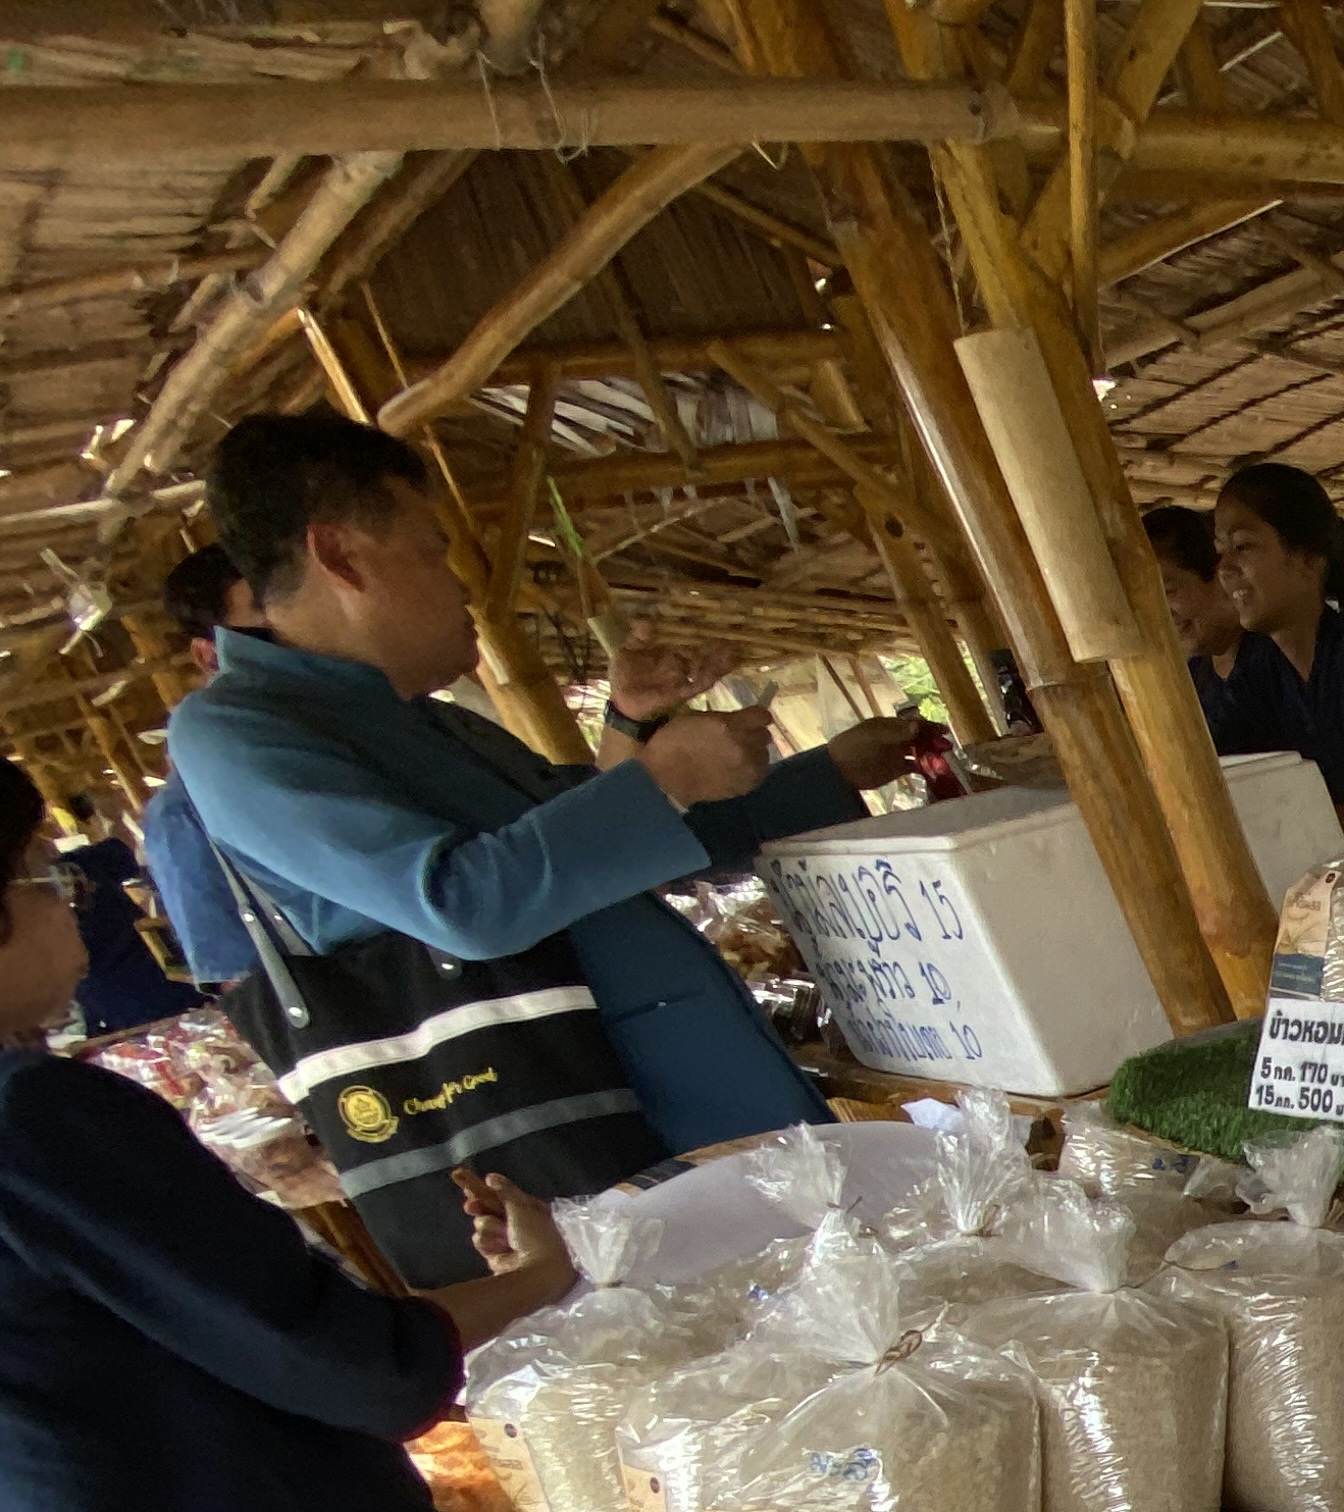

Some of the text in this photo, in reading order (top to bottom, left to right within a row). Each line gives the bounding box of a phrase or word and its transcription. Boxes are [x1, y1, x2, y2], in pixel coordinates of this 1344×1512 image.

[919, 880, 963, 940] 15
[919, 961, 952, 1005] 10
[949, 1020, 983, 1060] 10
[1261, 1057, 1272, 1079] 5
[1301, 1062, 1328, 1084] 170
[1256, 1084, 1274, 1105] 15
[1299, 1089, 1334, 1113] 500
